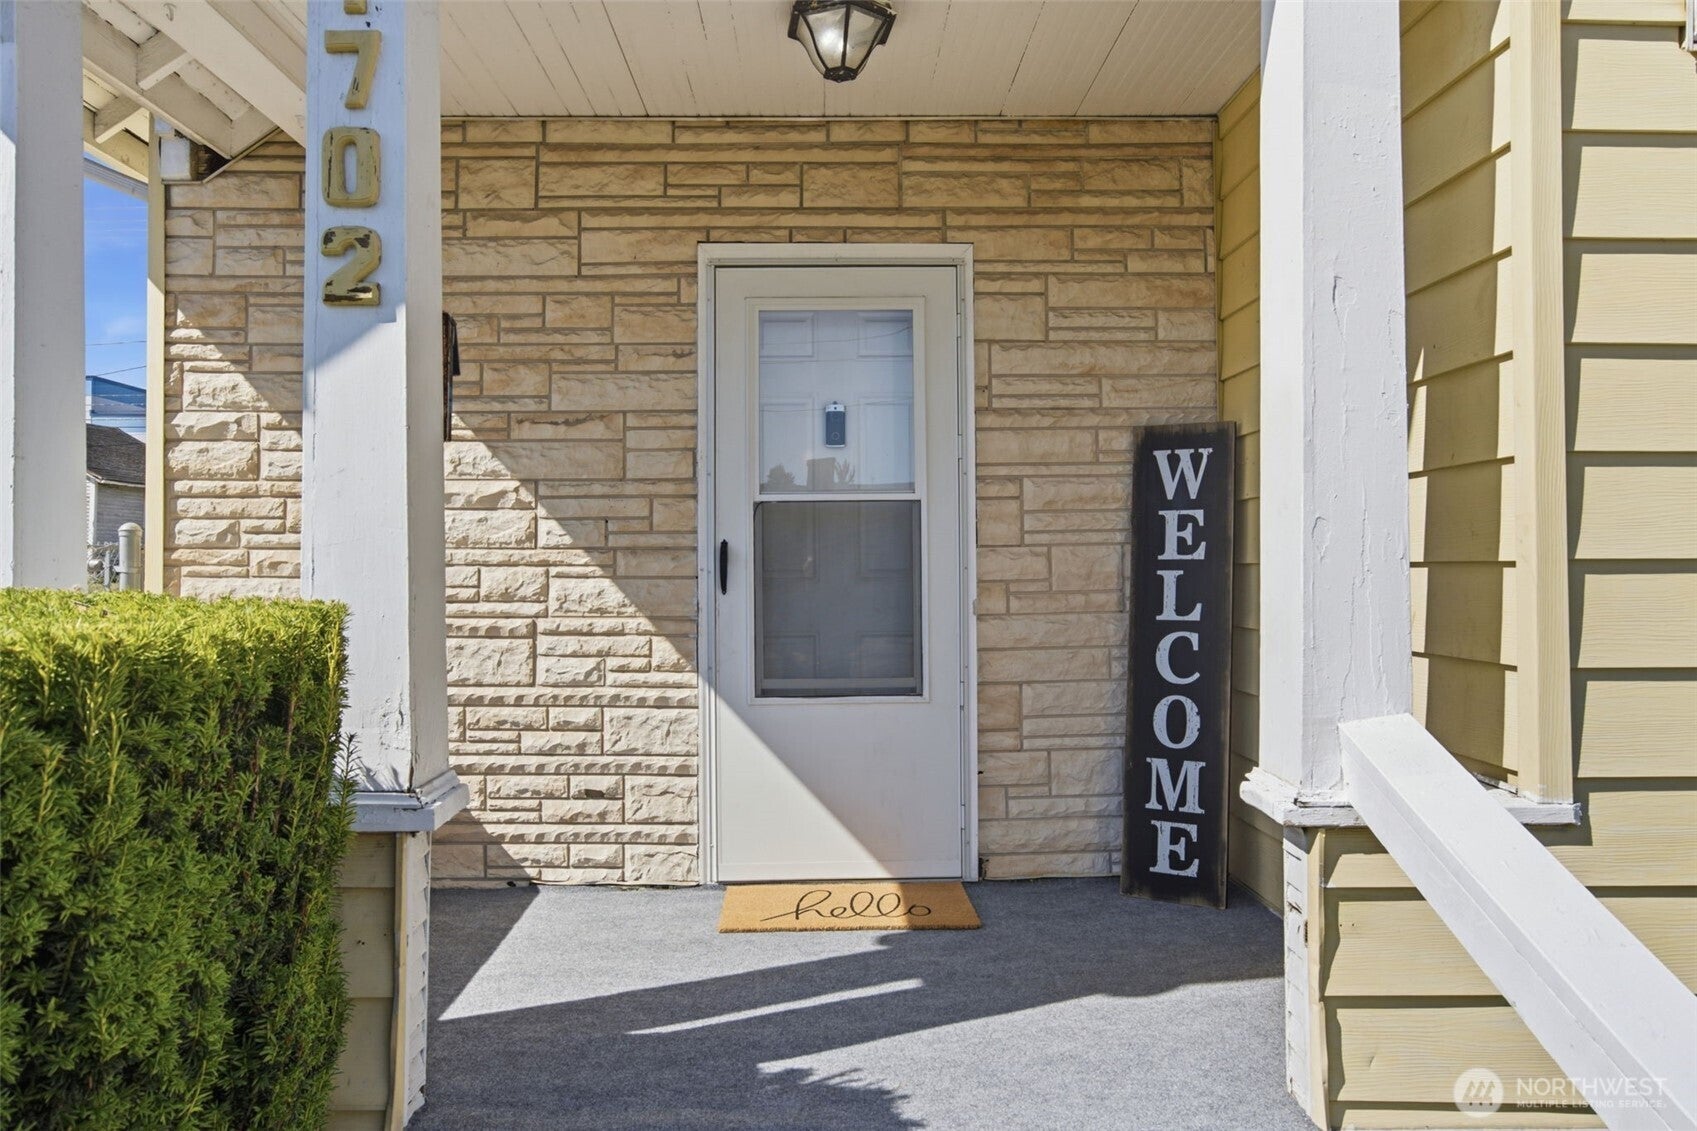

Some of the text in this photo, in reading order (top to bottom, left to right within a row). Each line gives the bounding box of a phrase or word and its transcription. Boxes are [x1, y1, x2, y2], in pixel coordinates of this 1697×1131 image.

[321, 0, 382, 307] 702
[1145, 447, 1213, 878] WELCOME
[760, 889, 932, 923] hello
